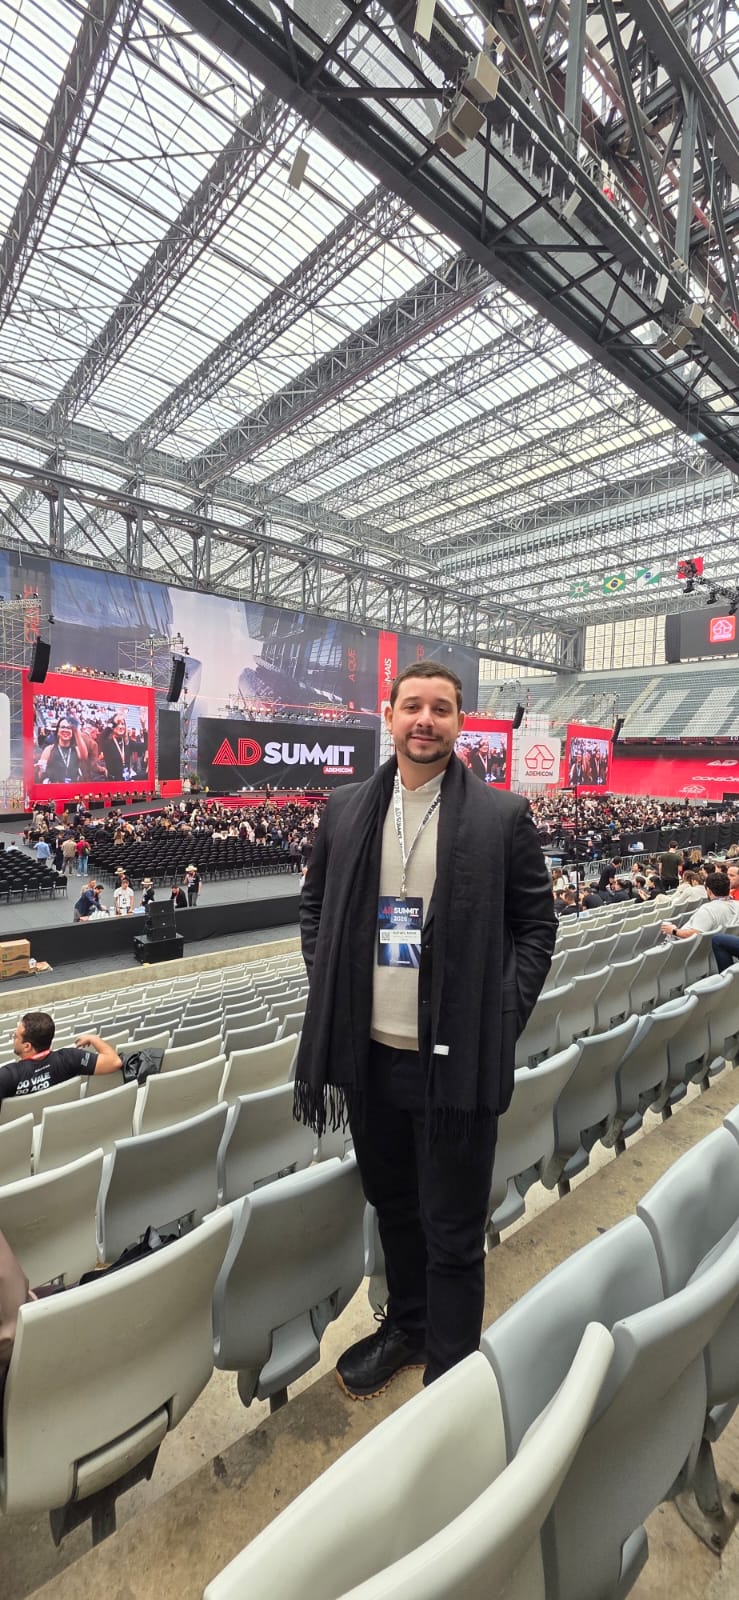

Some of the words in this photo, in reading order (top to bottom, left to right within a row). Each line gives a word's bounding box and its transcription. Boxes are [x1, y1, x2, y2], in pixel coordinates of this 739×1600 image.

[384, 658, 392, 683] MAIS
[212, 737, 262, 765] AD
[263, 741, 355, 766] SUMMIT
[394, 907, 419, 915] SUMMIT
[16, 1080, 30, 1090] DO
[30, 1072, 51, 1086] VALE
